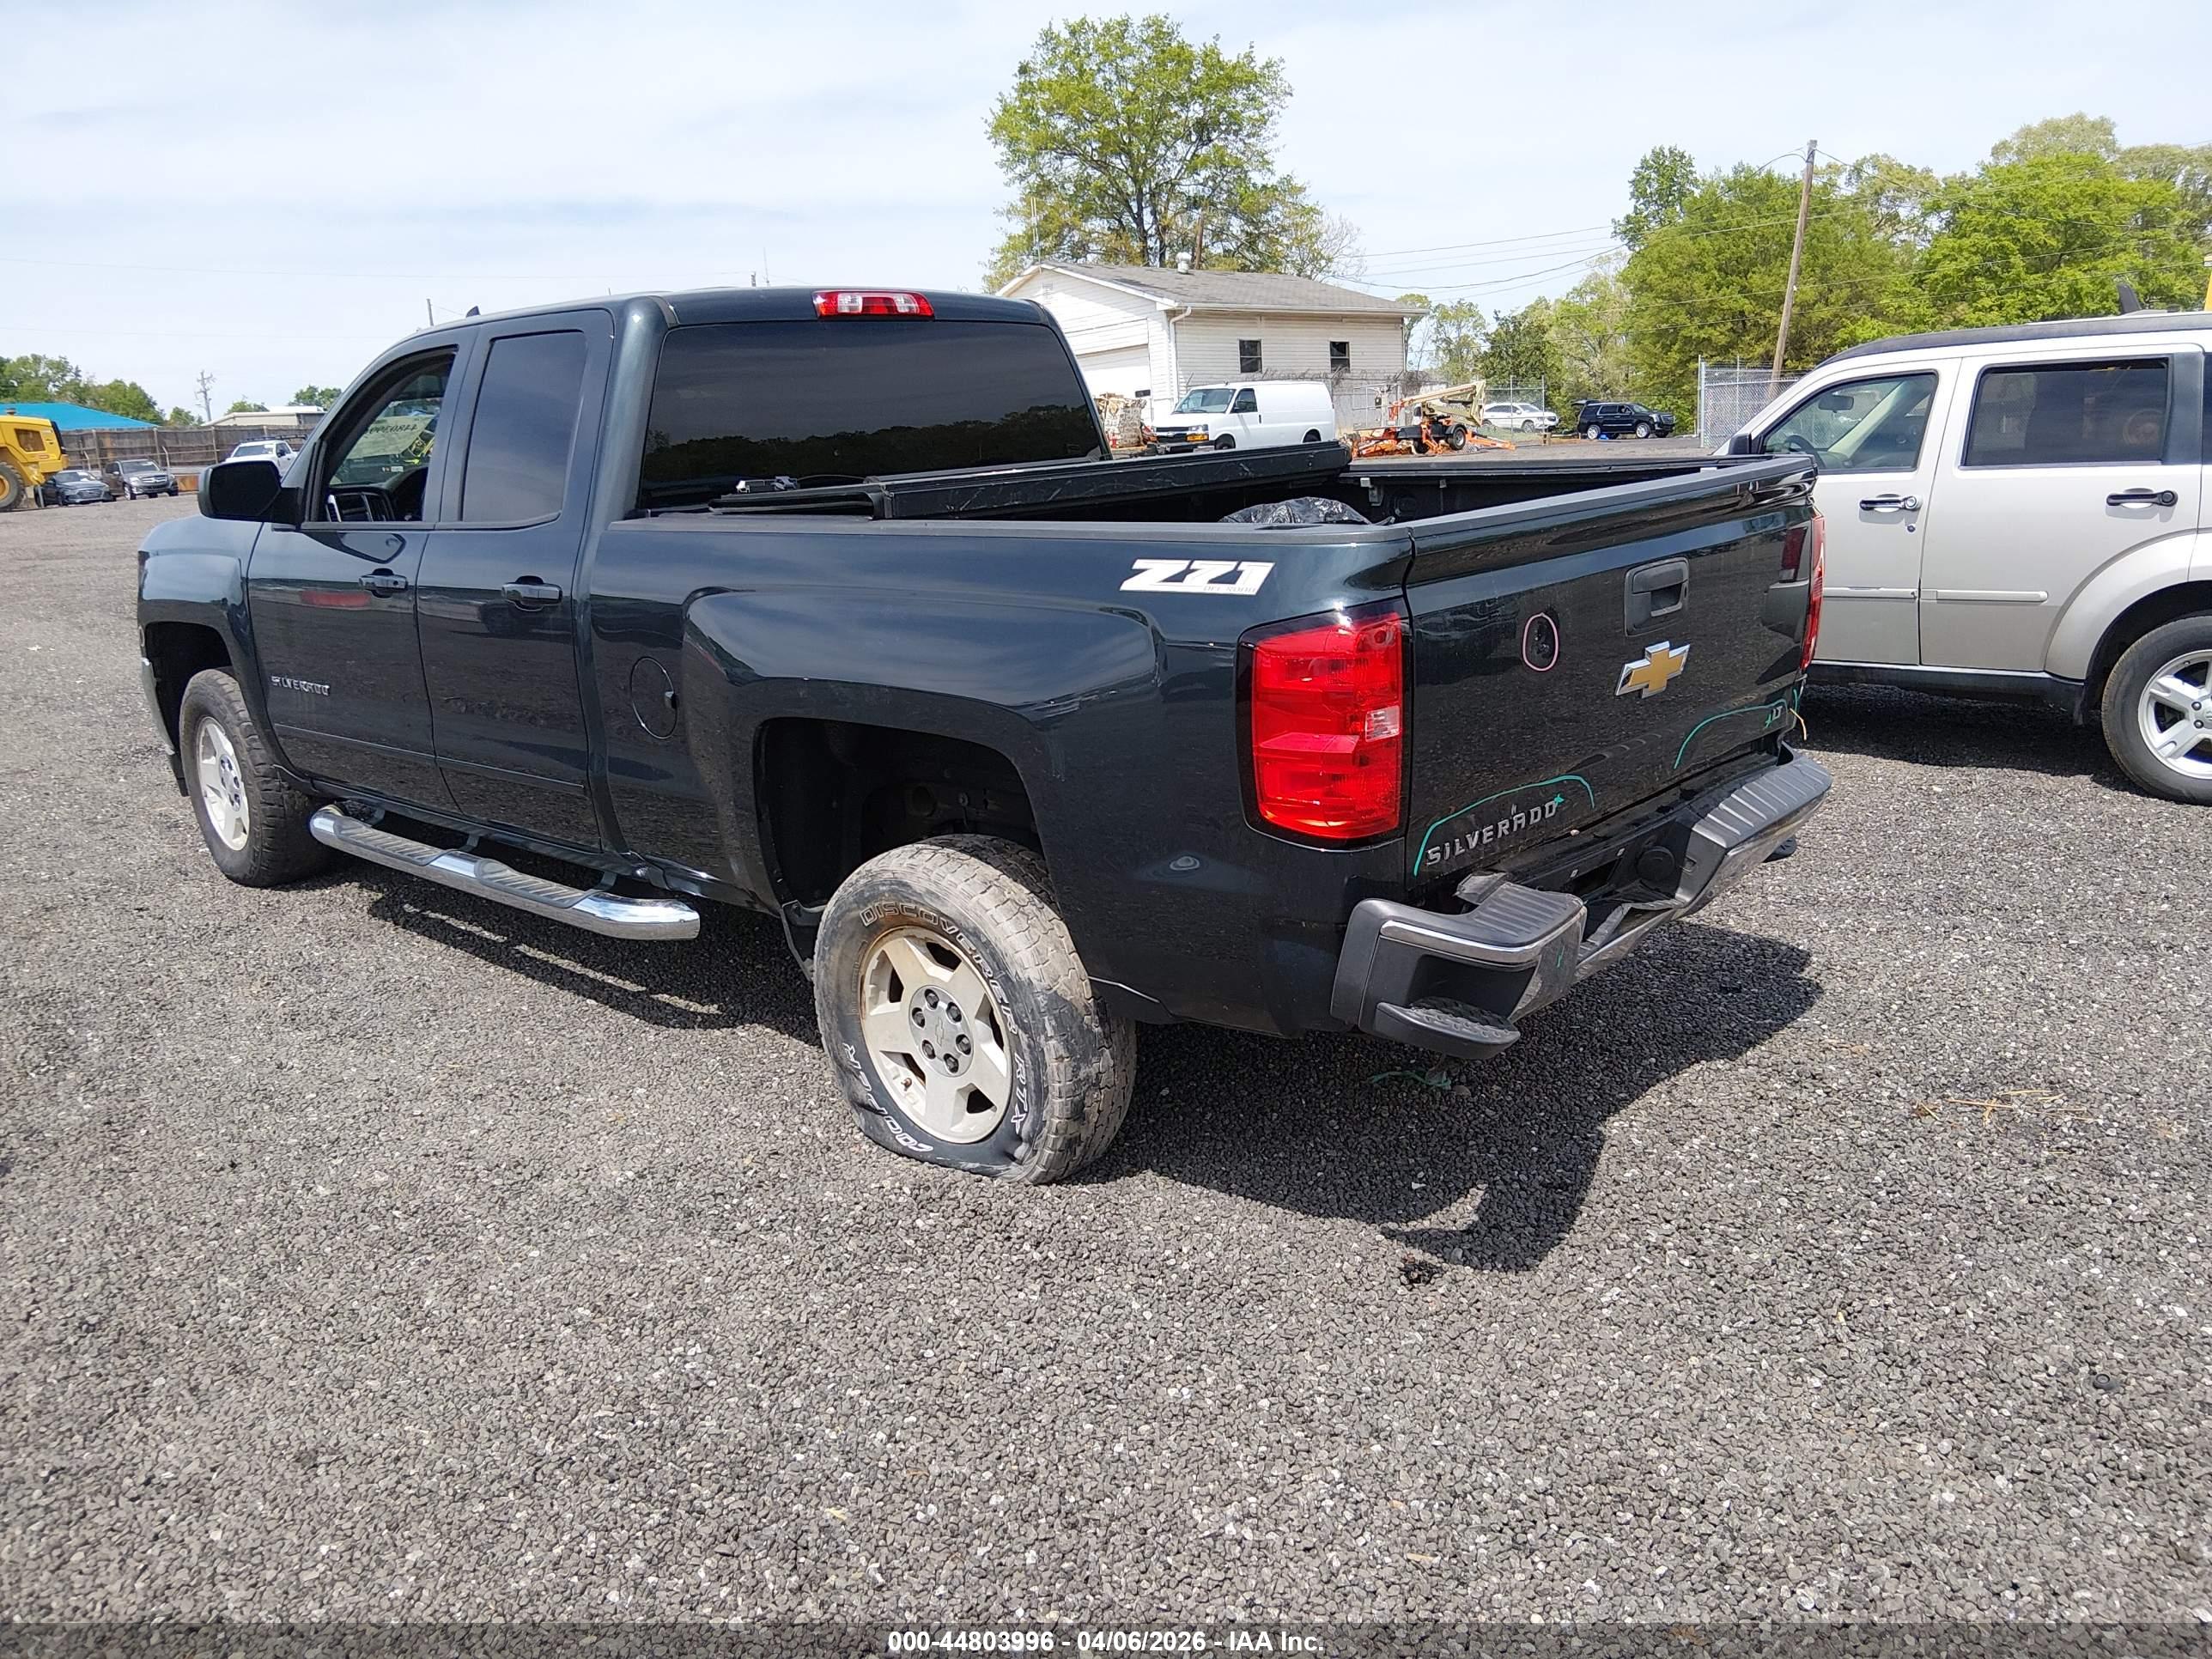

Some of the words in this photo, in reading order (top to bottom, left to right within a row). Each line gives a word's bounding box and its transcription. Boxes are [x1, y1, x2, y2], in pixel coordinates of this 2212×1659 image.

[1119, 559, 1276, 595] Z71
[271, 675, 330, 696] SILVERADO
[1425, 799, 1559, 865] SILVERADO
[860, 902, 1018, 1035] DISCOVERER
[1011, 1053, 1029, 1134] RTX
